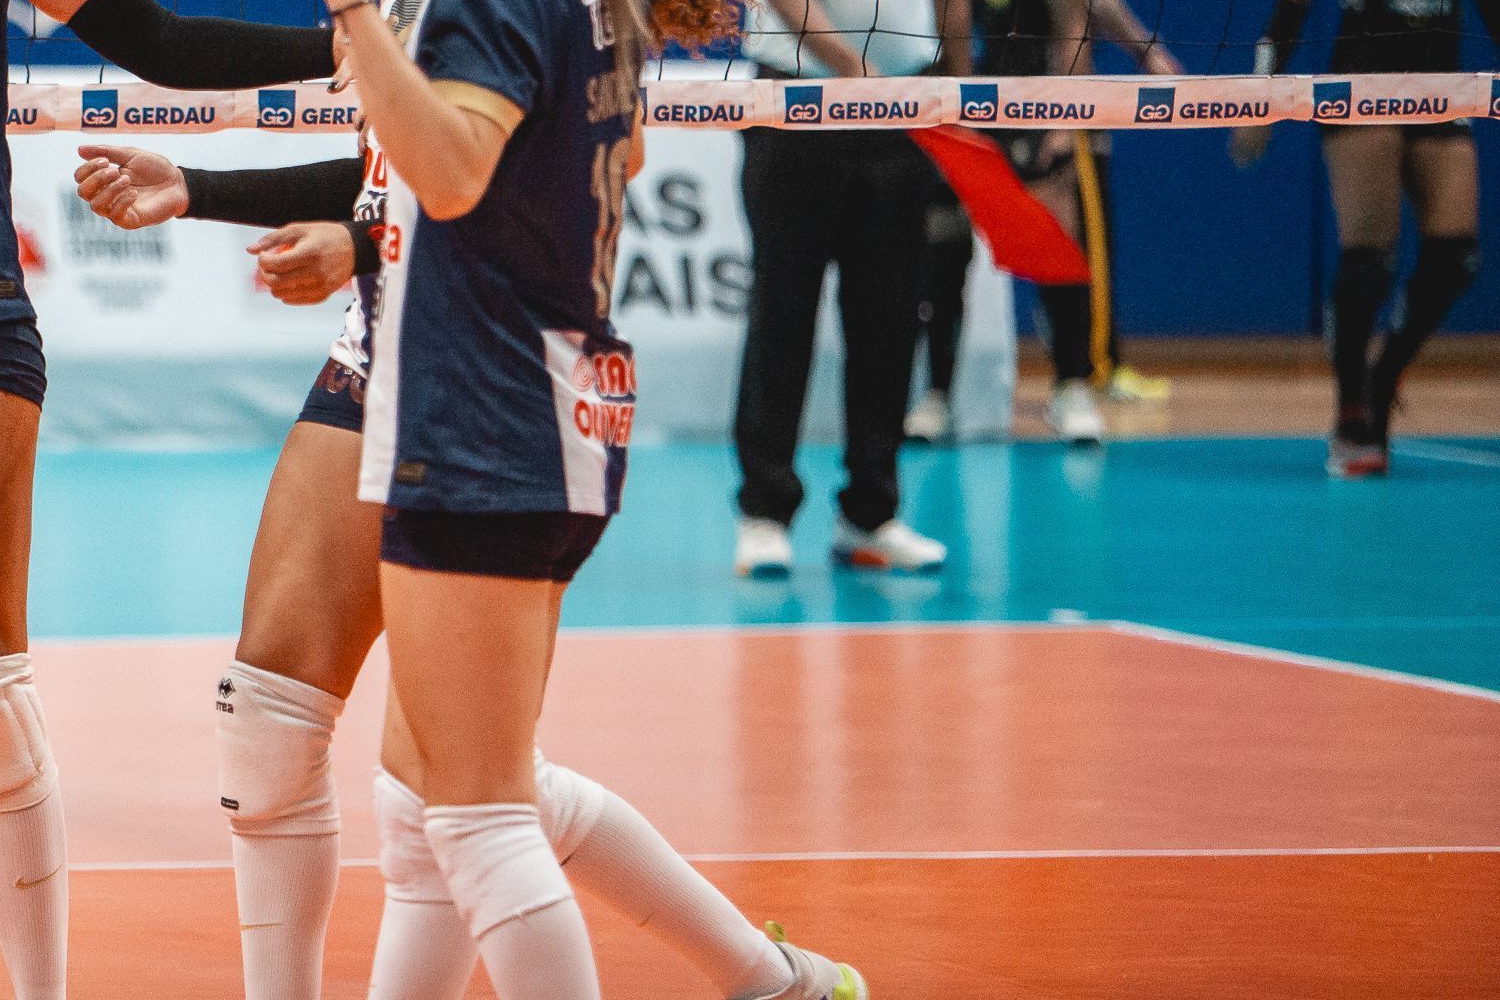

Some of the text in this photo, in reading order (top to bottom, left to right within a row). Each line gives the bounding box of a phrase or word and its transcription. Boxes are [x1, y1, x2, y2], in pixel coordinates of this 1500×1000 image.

[123, 106, 215, 125] GERDAU
[301, 107, 359, 125] GERD
[653, 104, 744, 123] GERDAU
[828, 101, 919, 120] GERDAU
[1004, 102, 1095, 120] GERDAU
[1179, 101, 1269, 119] GERDAU
[1357, 97, 1449, 116] GERDAU
